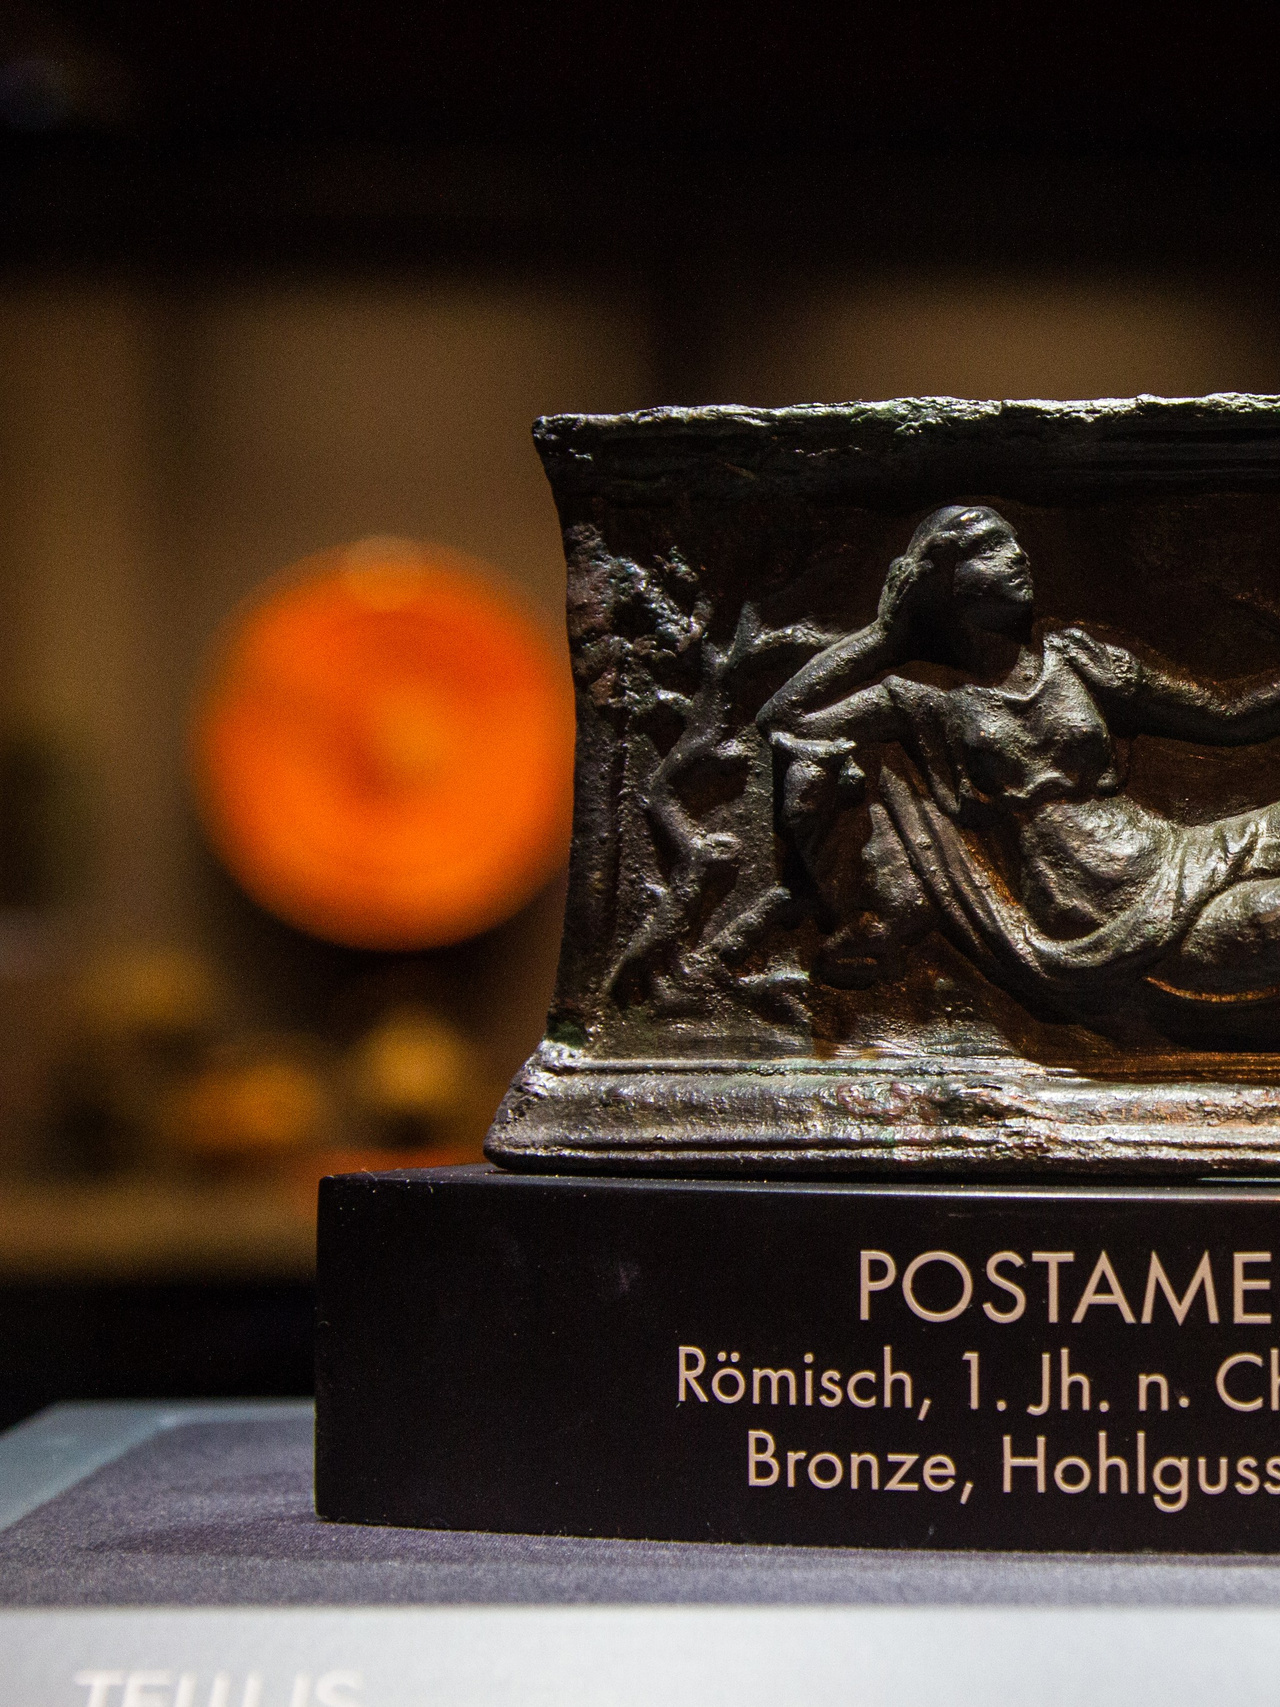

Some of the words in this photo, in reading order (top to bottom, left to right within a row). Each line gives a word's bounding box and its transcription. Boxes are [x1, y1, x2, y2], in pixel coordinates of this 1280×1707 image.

[678, 1346, 931, 1421] Römisch,
[962, 1352, 1006, 1412] 1.
[1026, 1348, 1113, 1416] Jh.
[1138, 1375, 1190, 1411] n.
[748, 1430, 973, 1505] Bronze,
